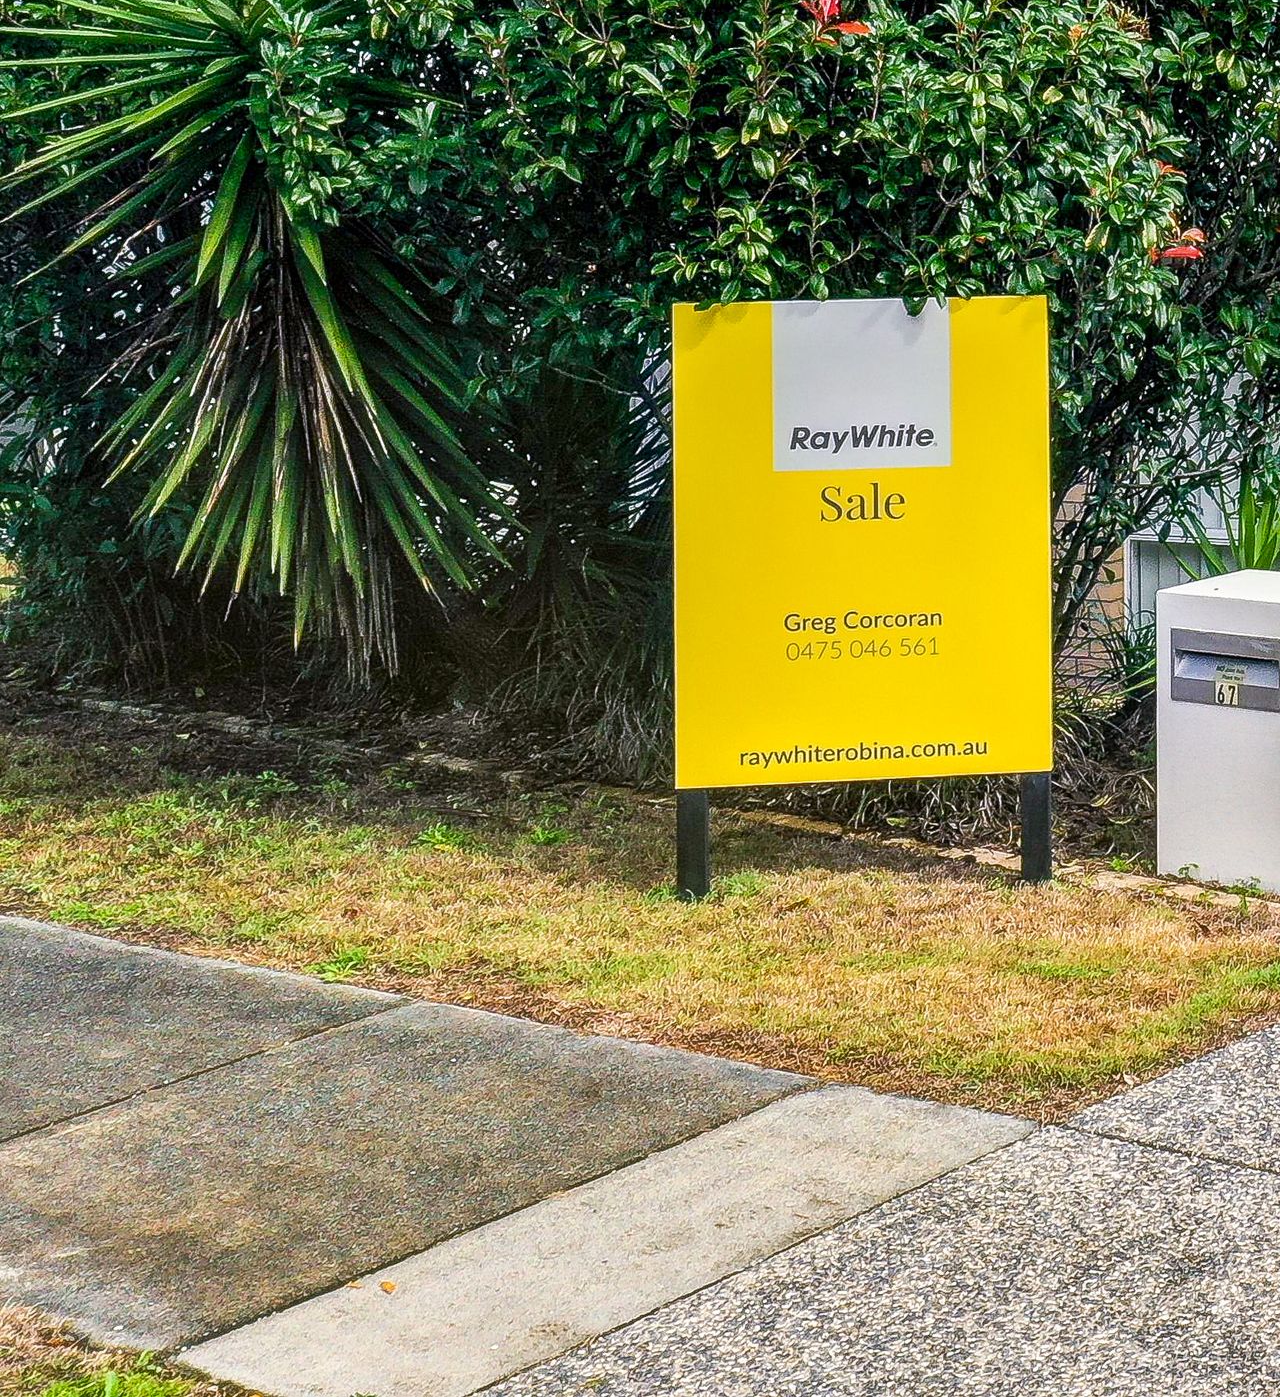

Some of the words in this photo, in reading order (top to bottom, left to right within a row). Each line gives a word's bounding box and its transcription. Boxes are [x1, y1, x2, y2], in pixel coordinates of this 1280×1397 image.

[820, 482, 905, 523] Sale
[783, 611, 836, 634] Greg
[843, 610, 943, 630] Corcoran
[786, 641, 841, 662] 0475
[849, 639, 892, 659] 046
[899, 636, 940, 657] 561
[1217, 684, 1236, 705] 67
[739, 741, 988, 770] raywhiterobina.com.au
